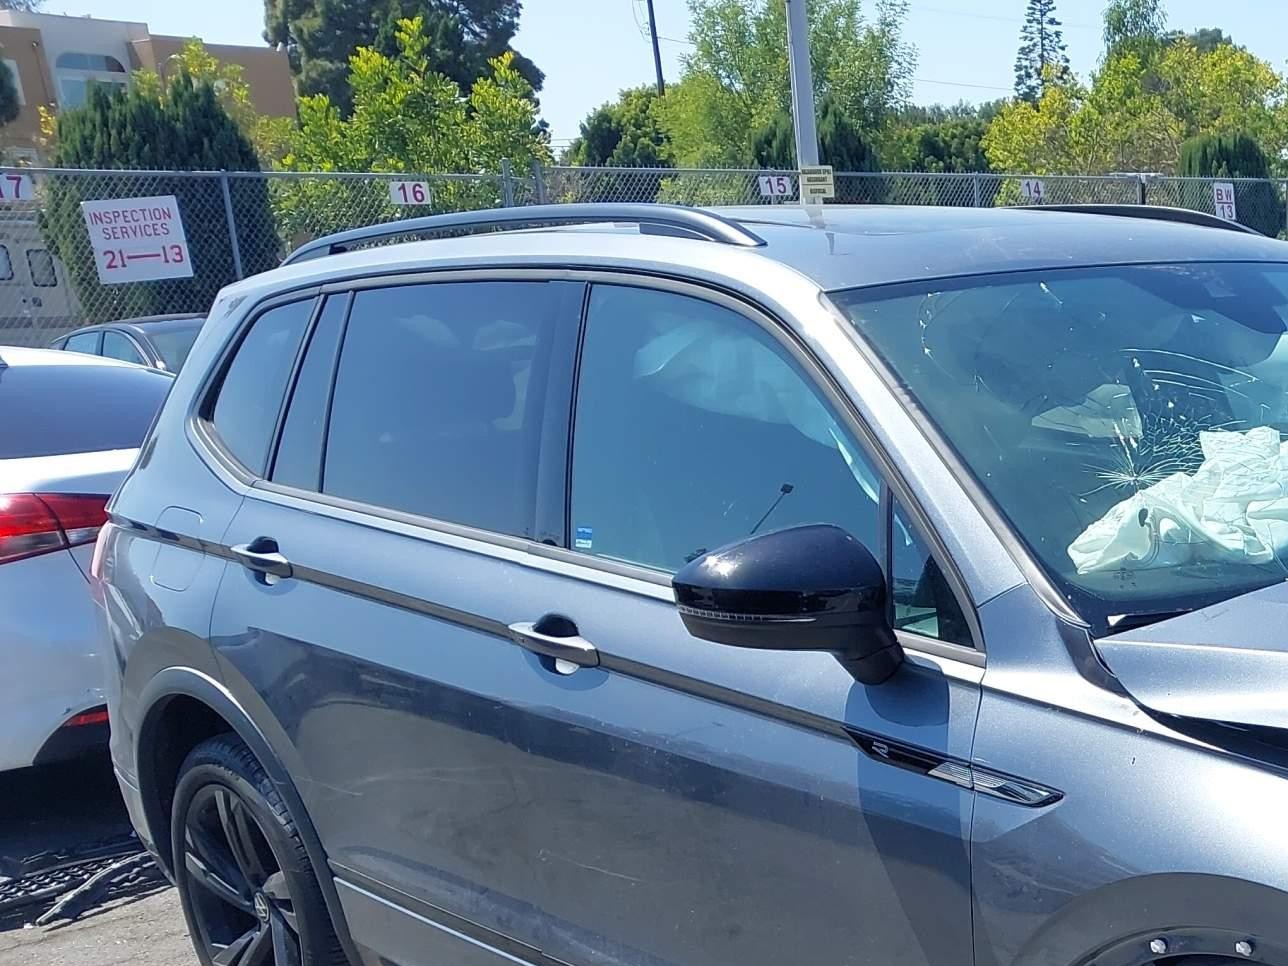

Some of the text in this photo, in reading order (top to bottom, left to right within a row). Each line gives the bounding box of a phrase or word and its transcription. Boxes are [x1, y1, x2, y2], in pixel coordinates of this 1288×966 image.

[398, 183, 425, 203] 16
[765, 177, 787, 194] 15
[1025, 181, 1041, 198] 14
[1216, 188, 1232, 201] BW
[88, 207, 172, 226] INSPECTION
[1219, 205, 1234, 219] 13
[102, 222, 170, 241] SERVICES
